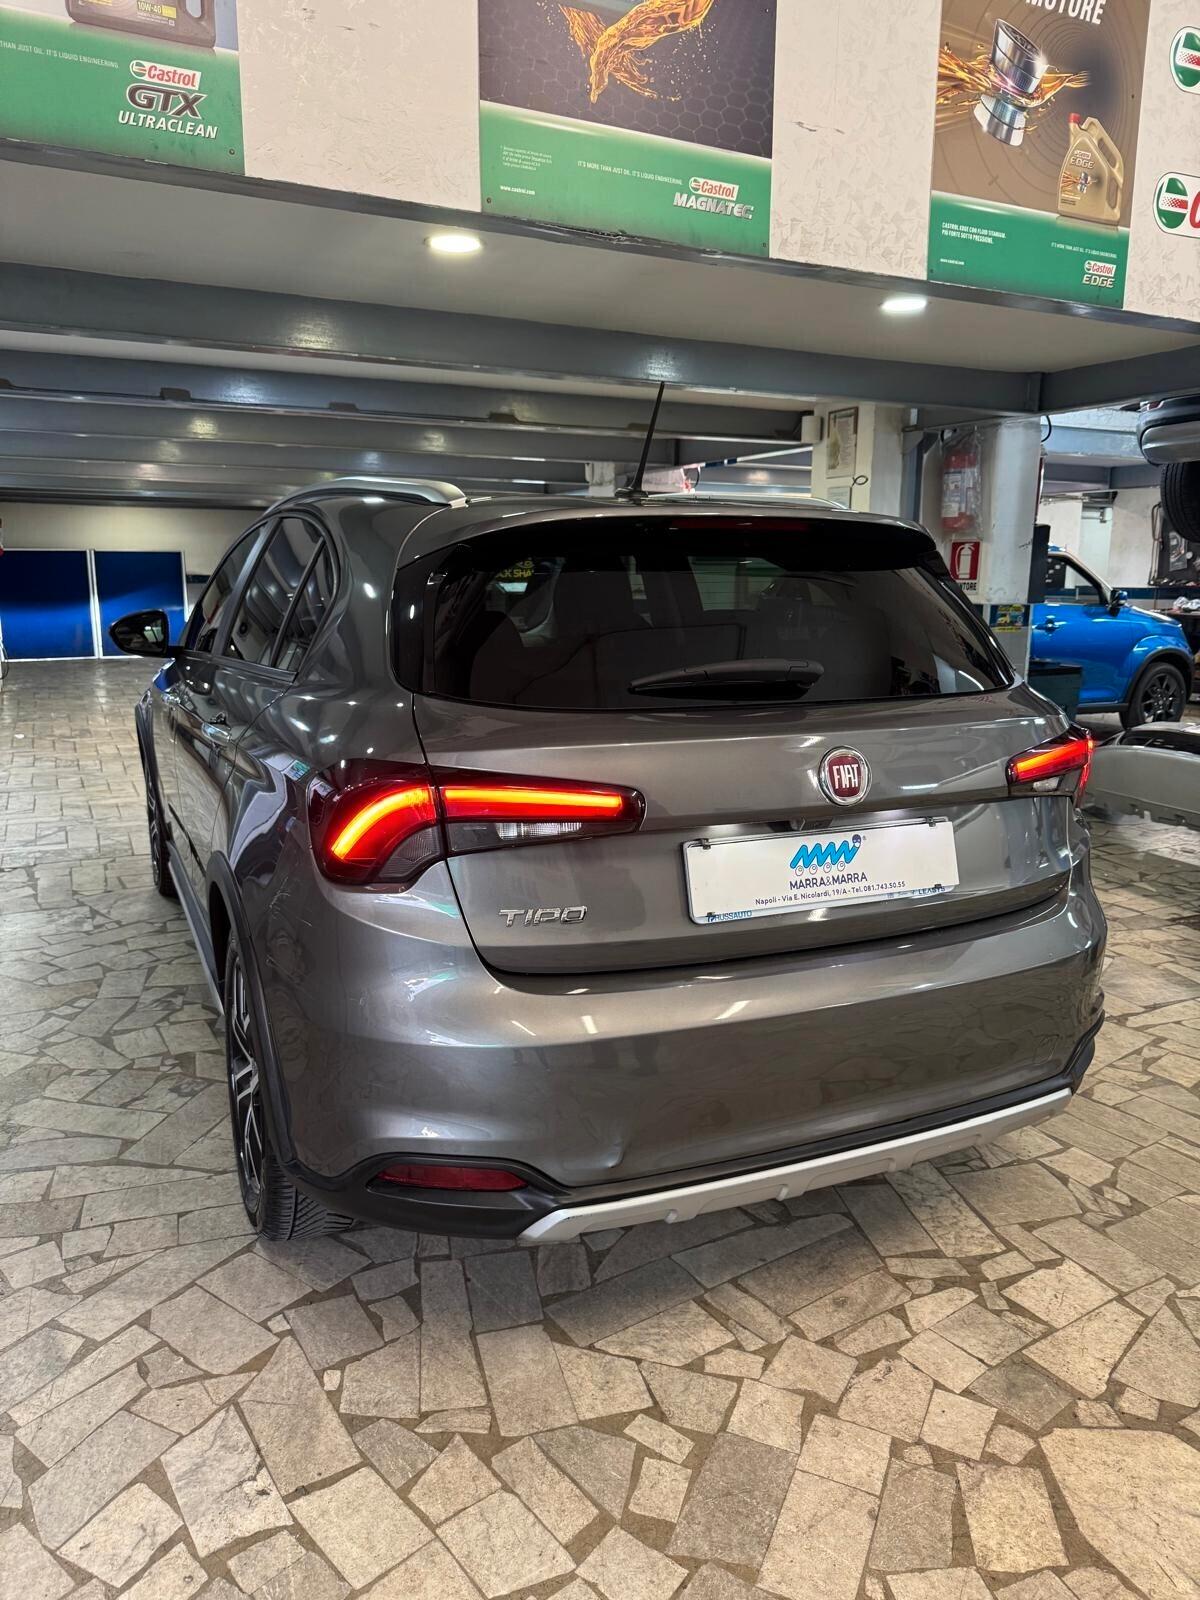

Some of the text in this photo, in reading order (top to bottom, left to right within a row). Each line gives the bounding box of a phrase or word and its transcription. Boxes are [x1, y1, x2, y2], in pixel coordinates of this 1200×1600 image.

[136, 1, 161, 14] 10W-40
[147, 65, 197, 88] Castrol
[126, 82, 208, 120] GTX
[118, 110, 218, 139] ULTRACLEAN
[1070, 156, 1095, 169] EDGE
[701, 180, 735, 198] Castrol
[673, 192, 754, 220] MAGNATEC
[1091, 263, 1114, 275] Castrol
[1082, 274, 1116, 288] EDGE
[832, 764, 859, 789] FIAT
[790, 872, 868, 890] MARRA&MARRA
[755, 896, 777, 906] Napoli
[832, 888, 847, 896] 19/A
[852, 886, 862, 894] Tel.
[863, 880, 906, 893] 081.743.50.55
[498, 905, 588, 927] TIPO
